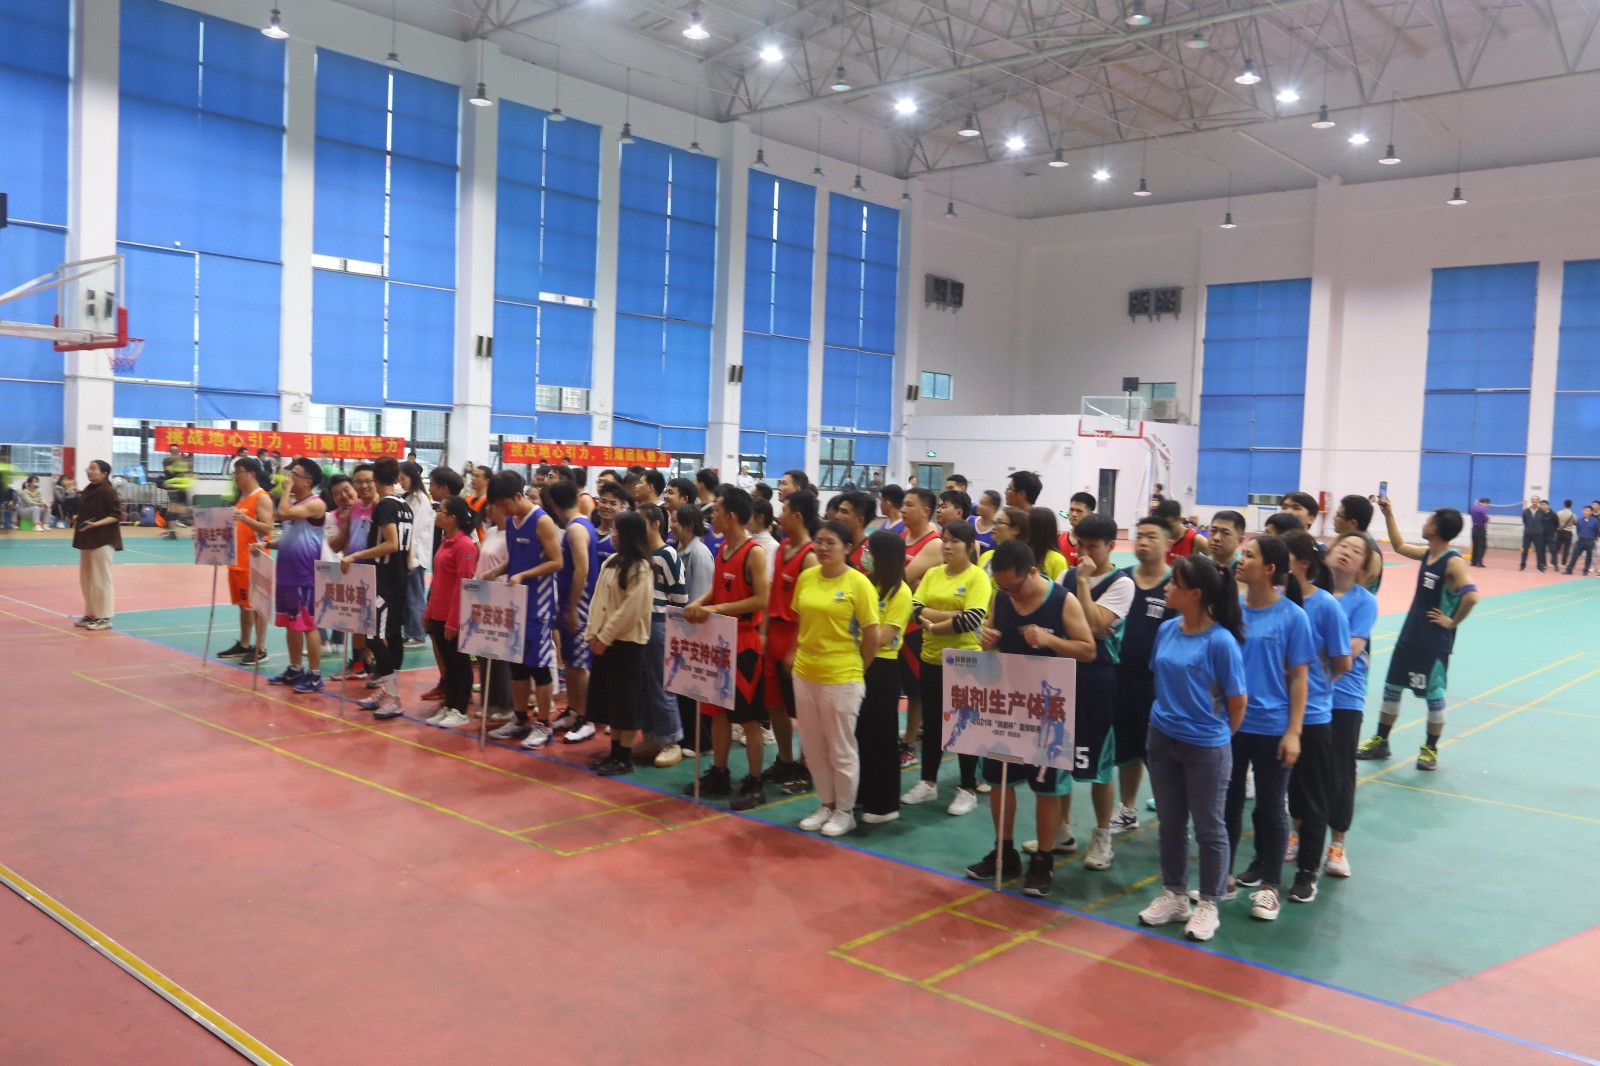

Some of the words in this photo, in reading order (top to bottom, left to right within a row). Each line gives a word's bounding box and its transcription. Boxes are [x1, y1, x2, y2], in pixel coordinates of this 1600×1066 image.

[472, 604, 515, 629] 研发体系
[669, 636, 731, 669] 生产支持体系
[1408, 671, 1427, 690] 30
[951, 684, 1066, 722] 制剂生产体系
[1074, 746, 1090, 769] 5
